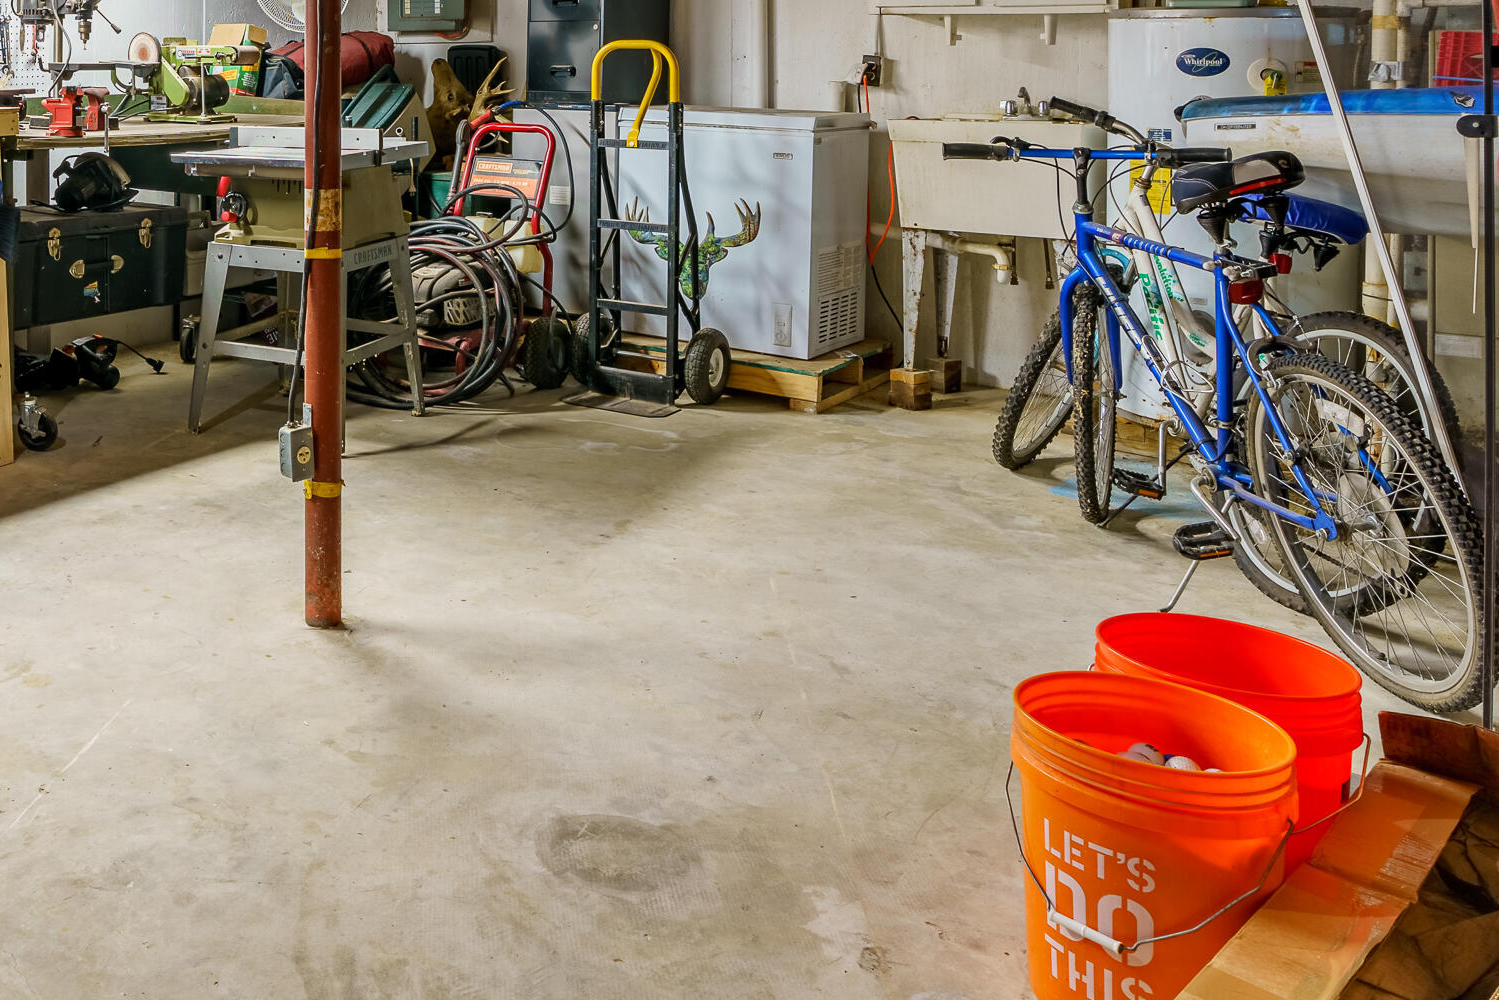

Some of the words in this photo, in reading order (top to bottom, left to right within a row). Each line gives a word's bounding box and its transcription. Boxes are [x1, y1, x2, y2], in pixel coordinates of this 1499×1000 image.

[1183, 57, 1224, 67] Whirlpool
[478, 163, 510, 171] CRAFTSMAN
[353, 244, 394, 265] CRAFTSMAN
[1138, 273, 1164, 342] Pacific
[1044, 817, 1156, 893] LET'S
[1044, 860, 1155, 967] DO
[1044, 933, 1154, 1000] THIS
